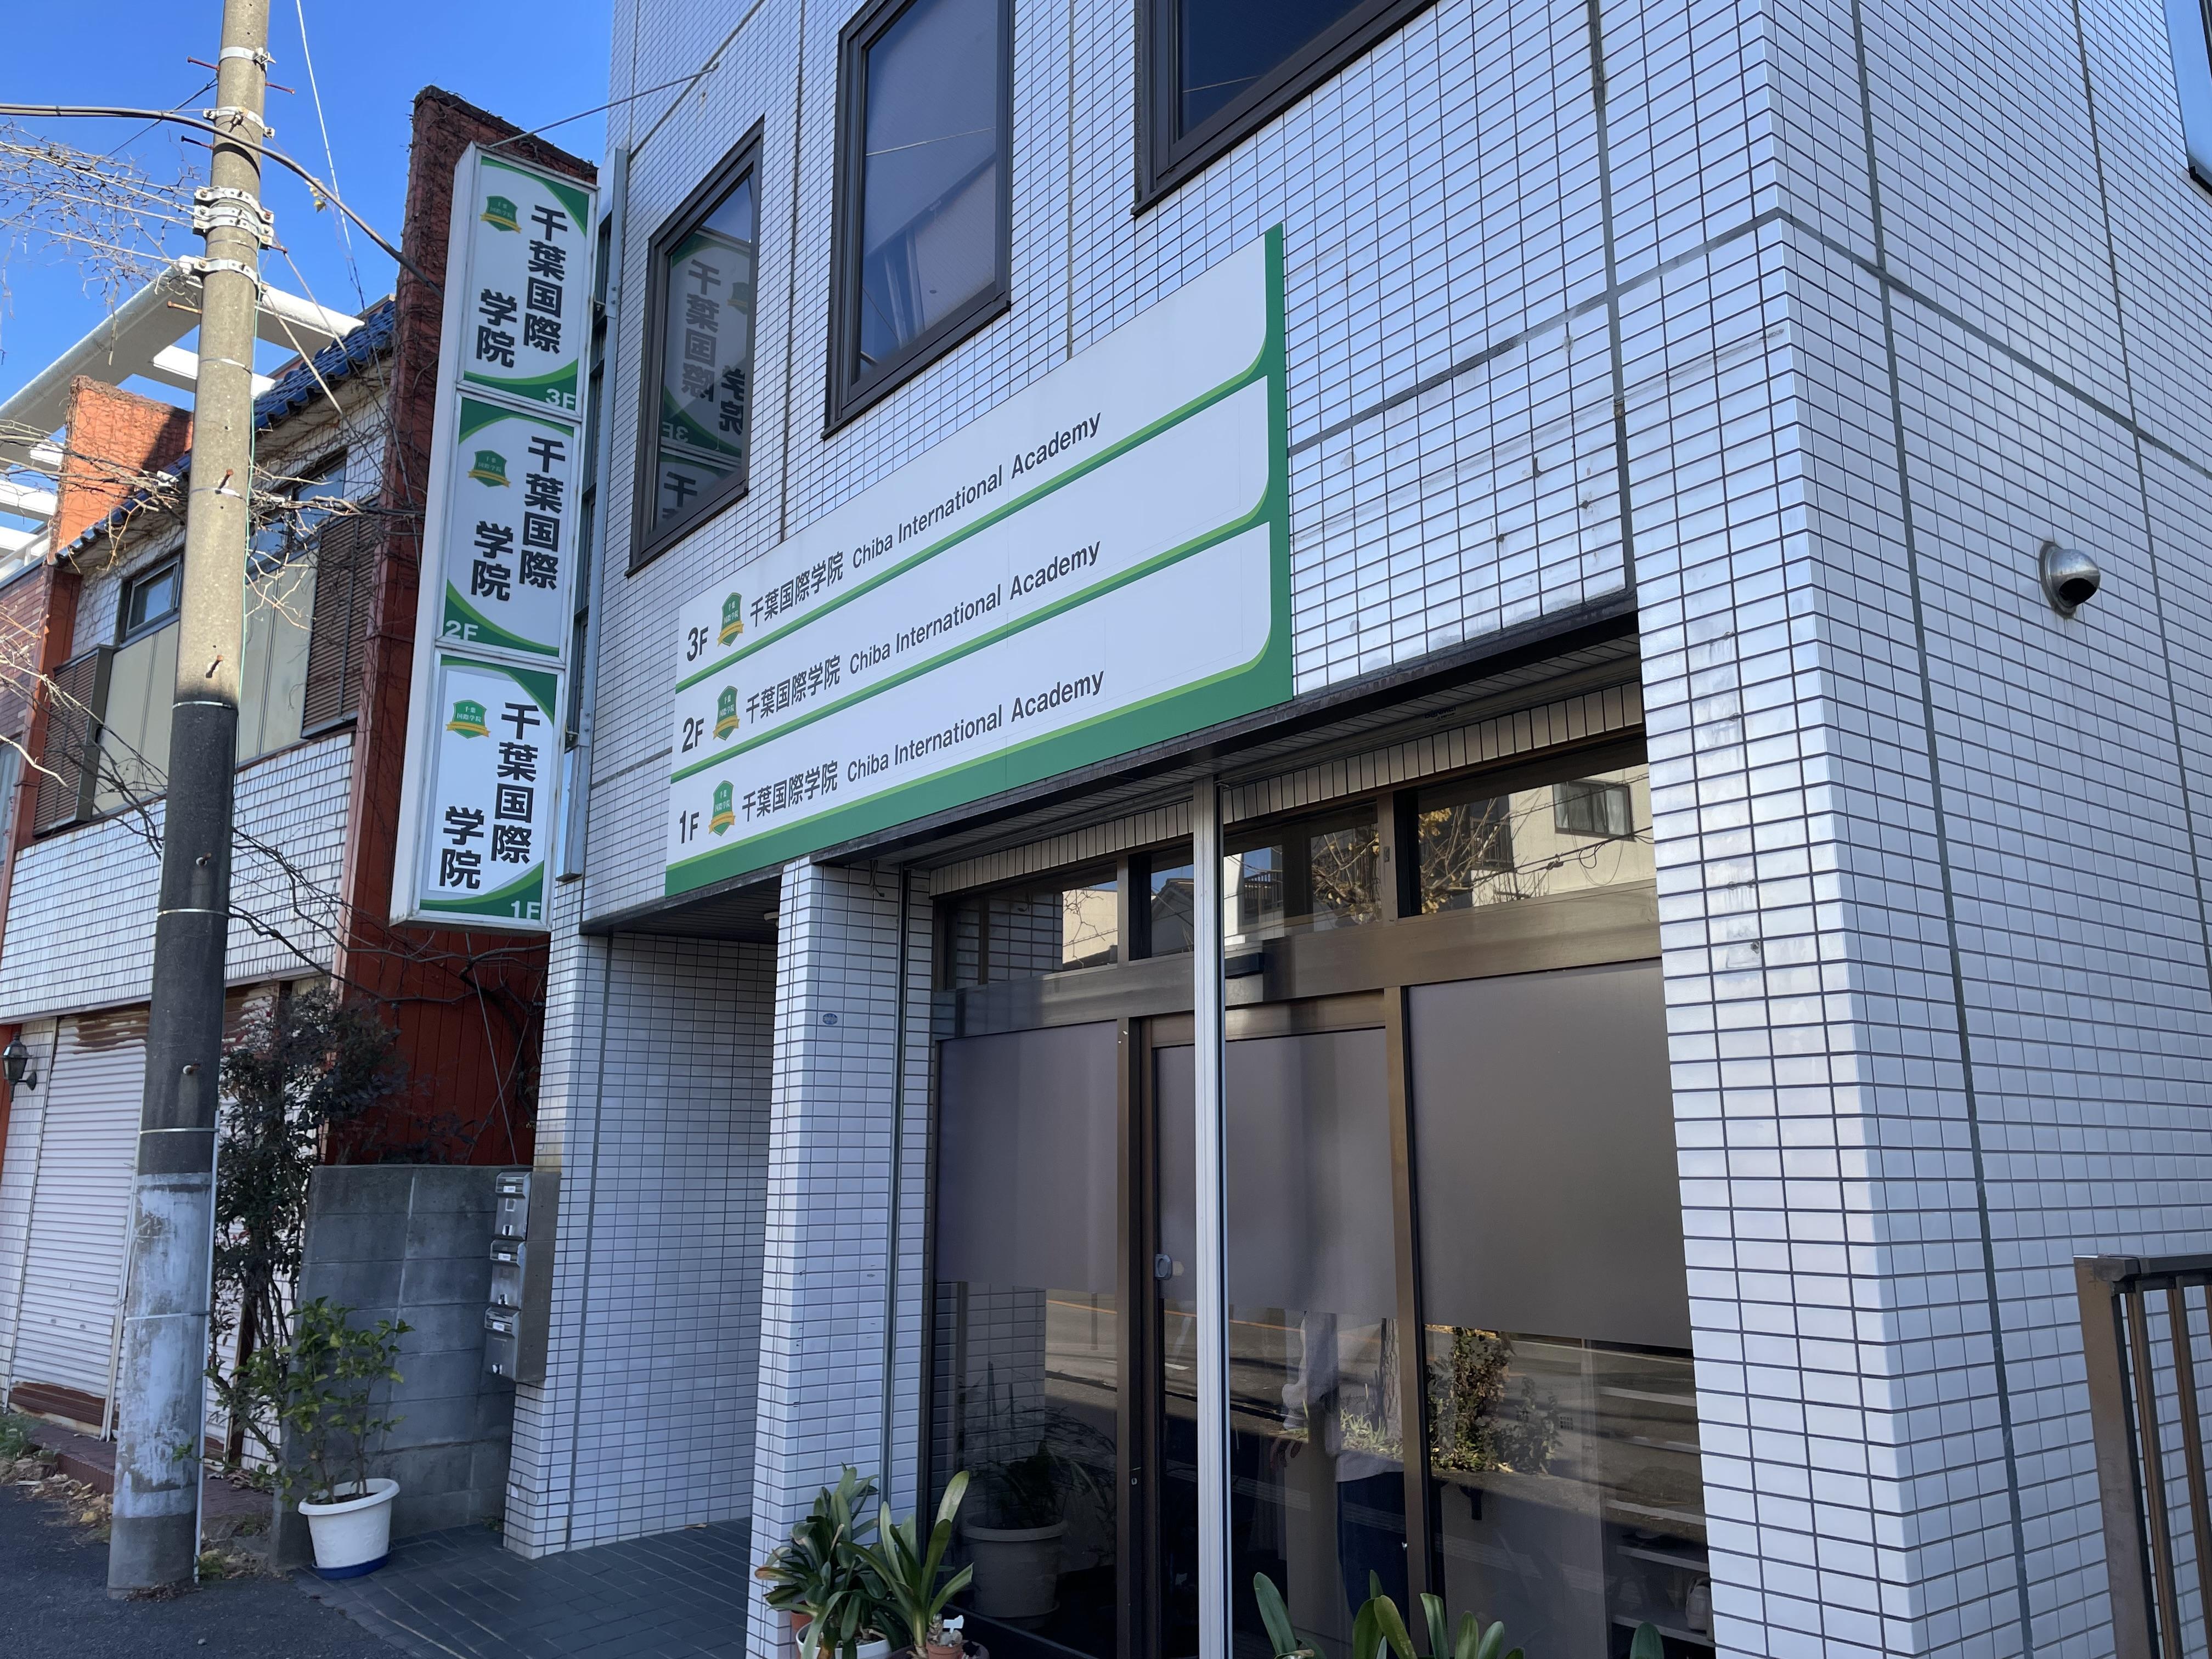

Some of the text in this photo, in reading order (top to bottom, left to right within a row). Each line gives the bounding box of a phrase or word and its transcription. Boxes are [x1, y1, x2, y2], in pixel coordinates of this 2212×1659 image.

[476, 288, 518, 368] 学院
[523, 204, 568, 354] 千葉国際
[545, 388, 576, 409] 3F
[470, 520, 514, 601] 学院
[519, 435, 566, 590] 千葉国際
[686, 412, 1101, 662] 3F 千葉国際学院 Chiba International Academy
[444, 619, 479, 641] 2F
[681, 540, 1101, 754] 2F 千葉国際学院 Chiba International Academy
[490, 702, 540, 865] 千葉国際
[679, 670, 1104, 845] 1F 千葉国際学院 Chiba International Academy
[438, 805, 484, 890] 学院
[510, 900, 540, 919] 1F
